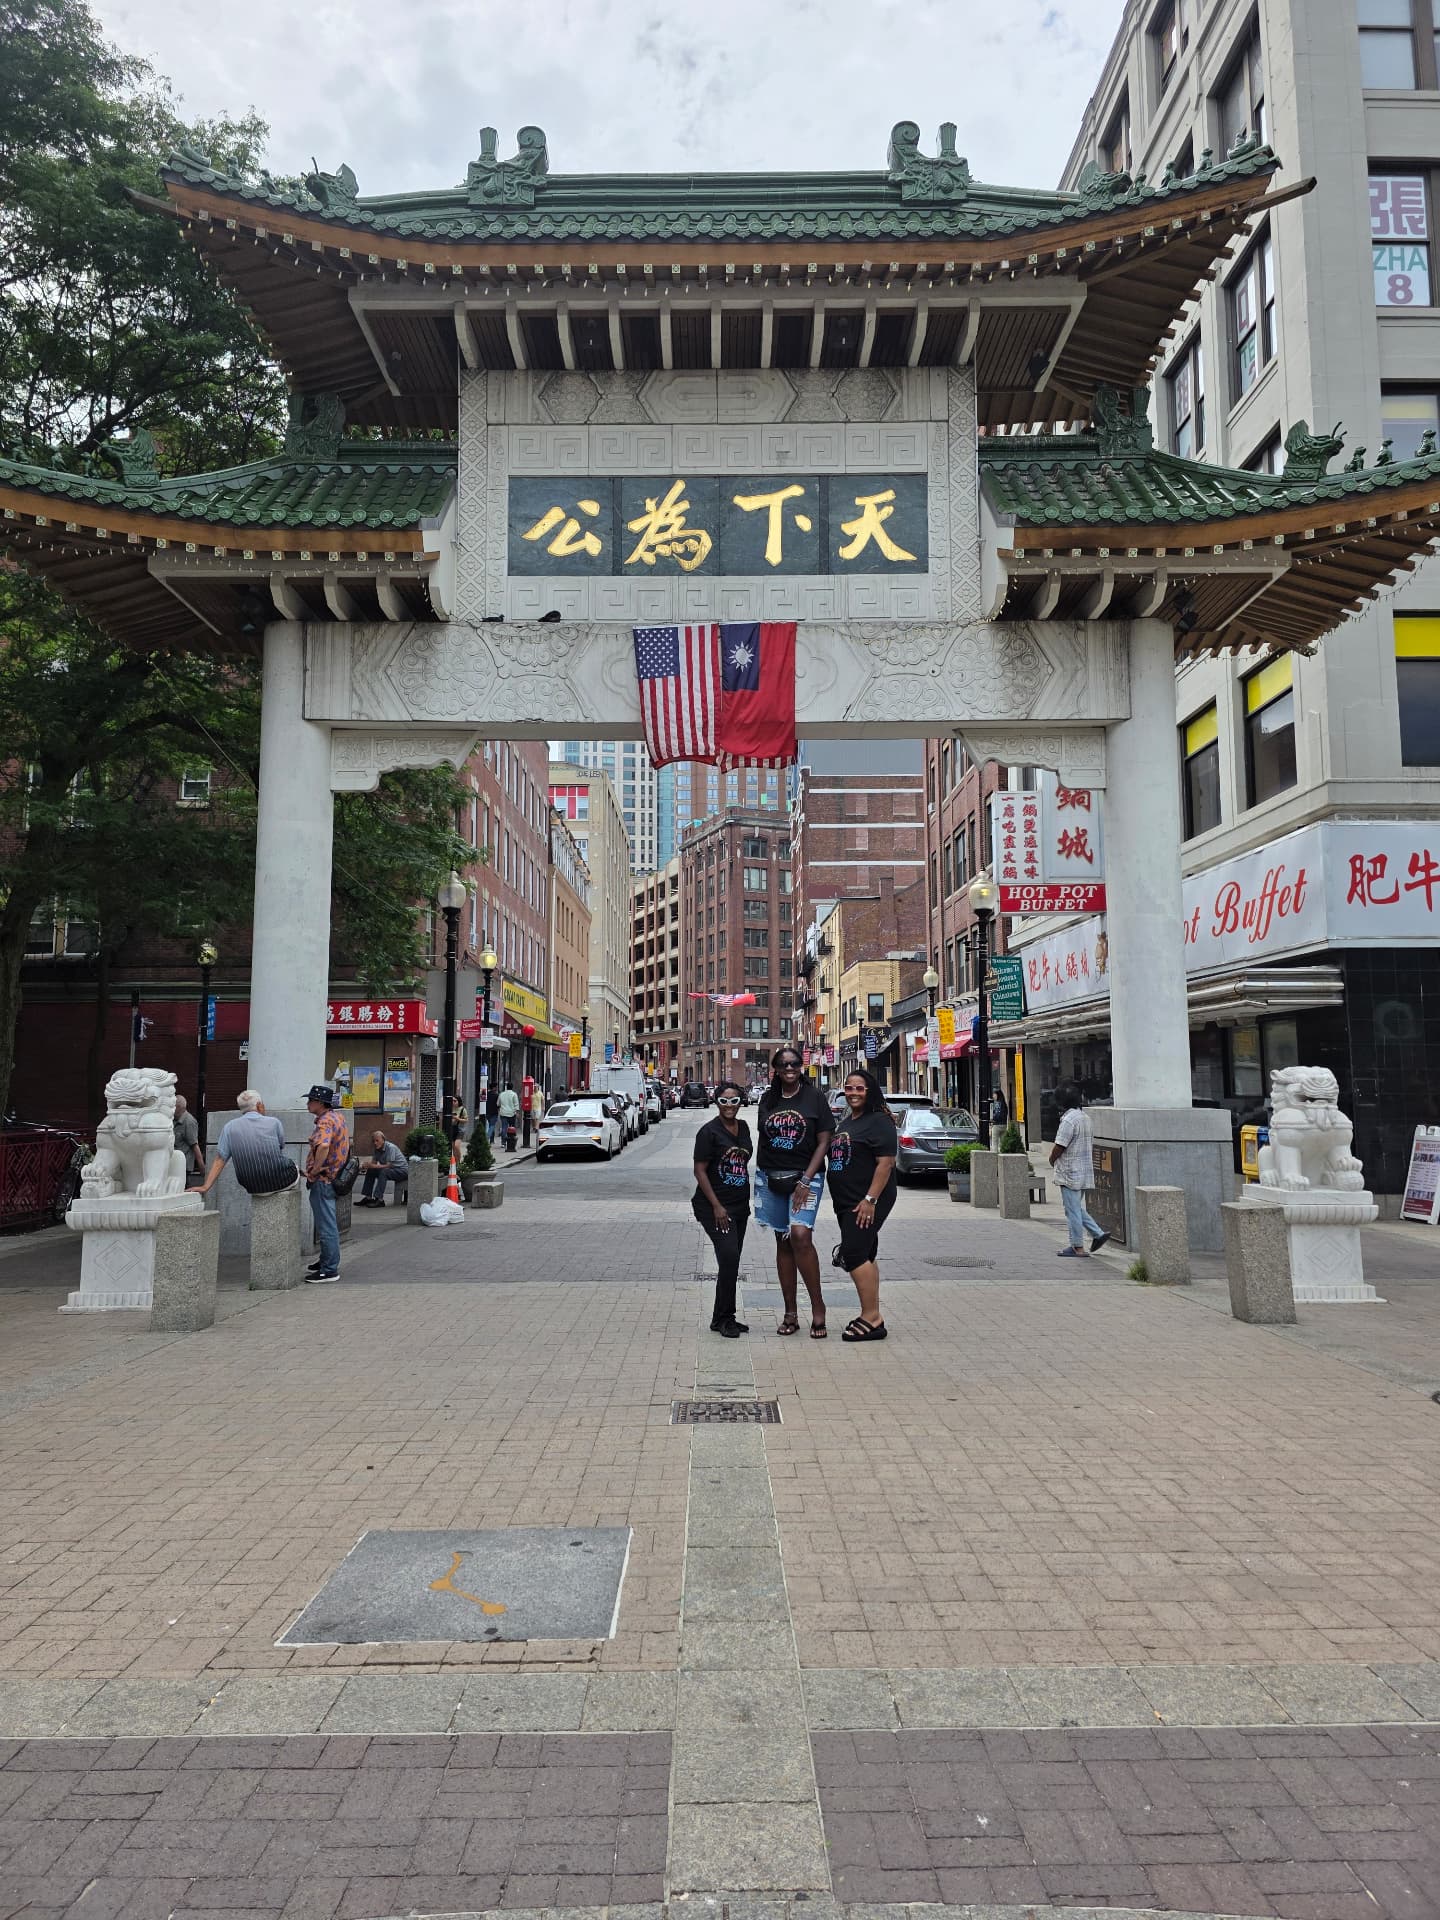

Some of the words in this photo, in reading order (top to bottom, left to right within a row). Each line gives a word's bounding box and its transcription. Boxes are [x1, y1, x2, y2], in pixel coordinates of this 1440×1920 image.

[1387, 274, 1413, 304] 8
[1008, 887, 1048, 899] HOT
[1059, 886, 1098, 898] POT
[1019, 899, 1088, 911] BUFFET
[1212, 864, 1308, 944] Buffet
